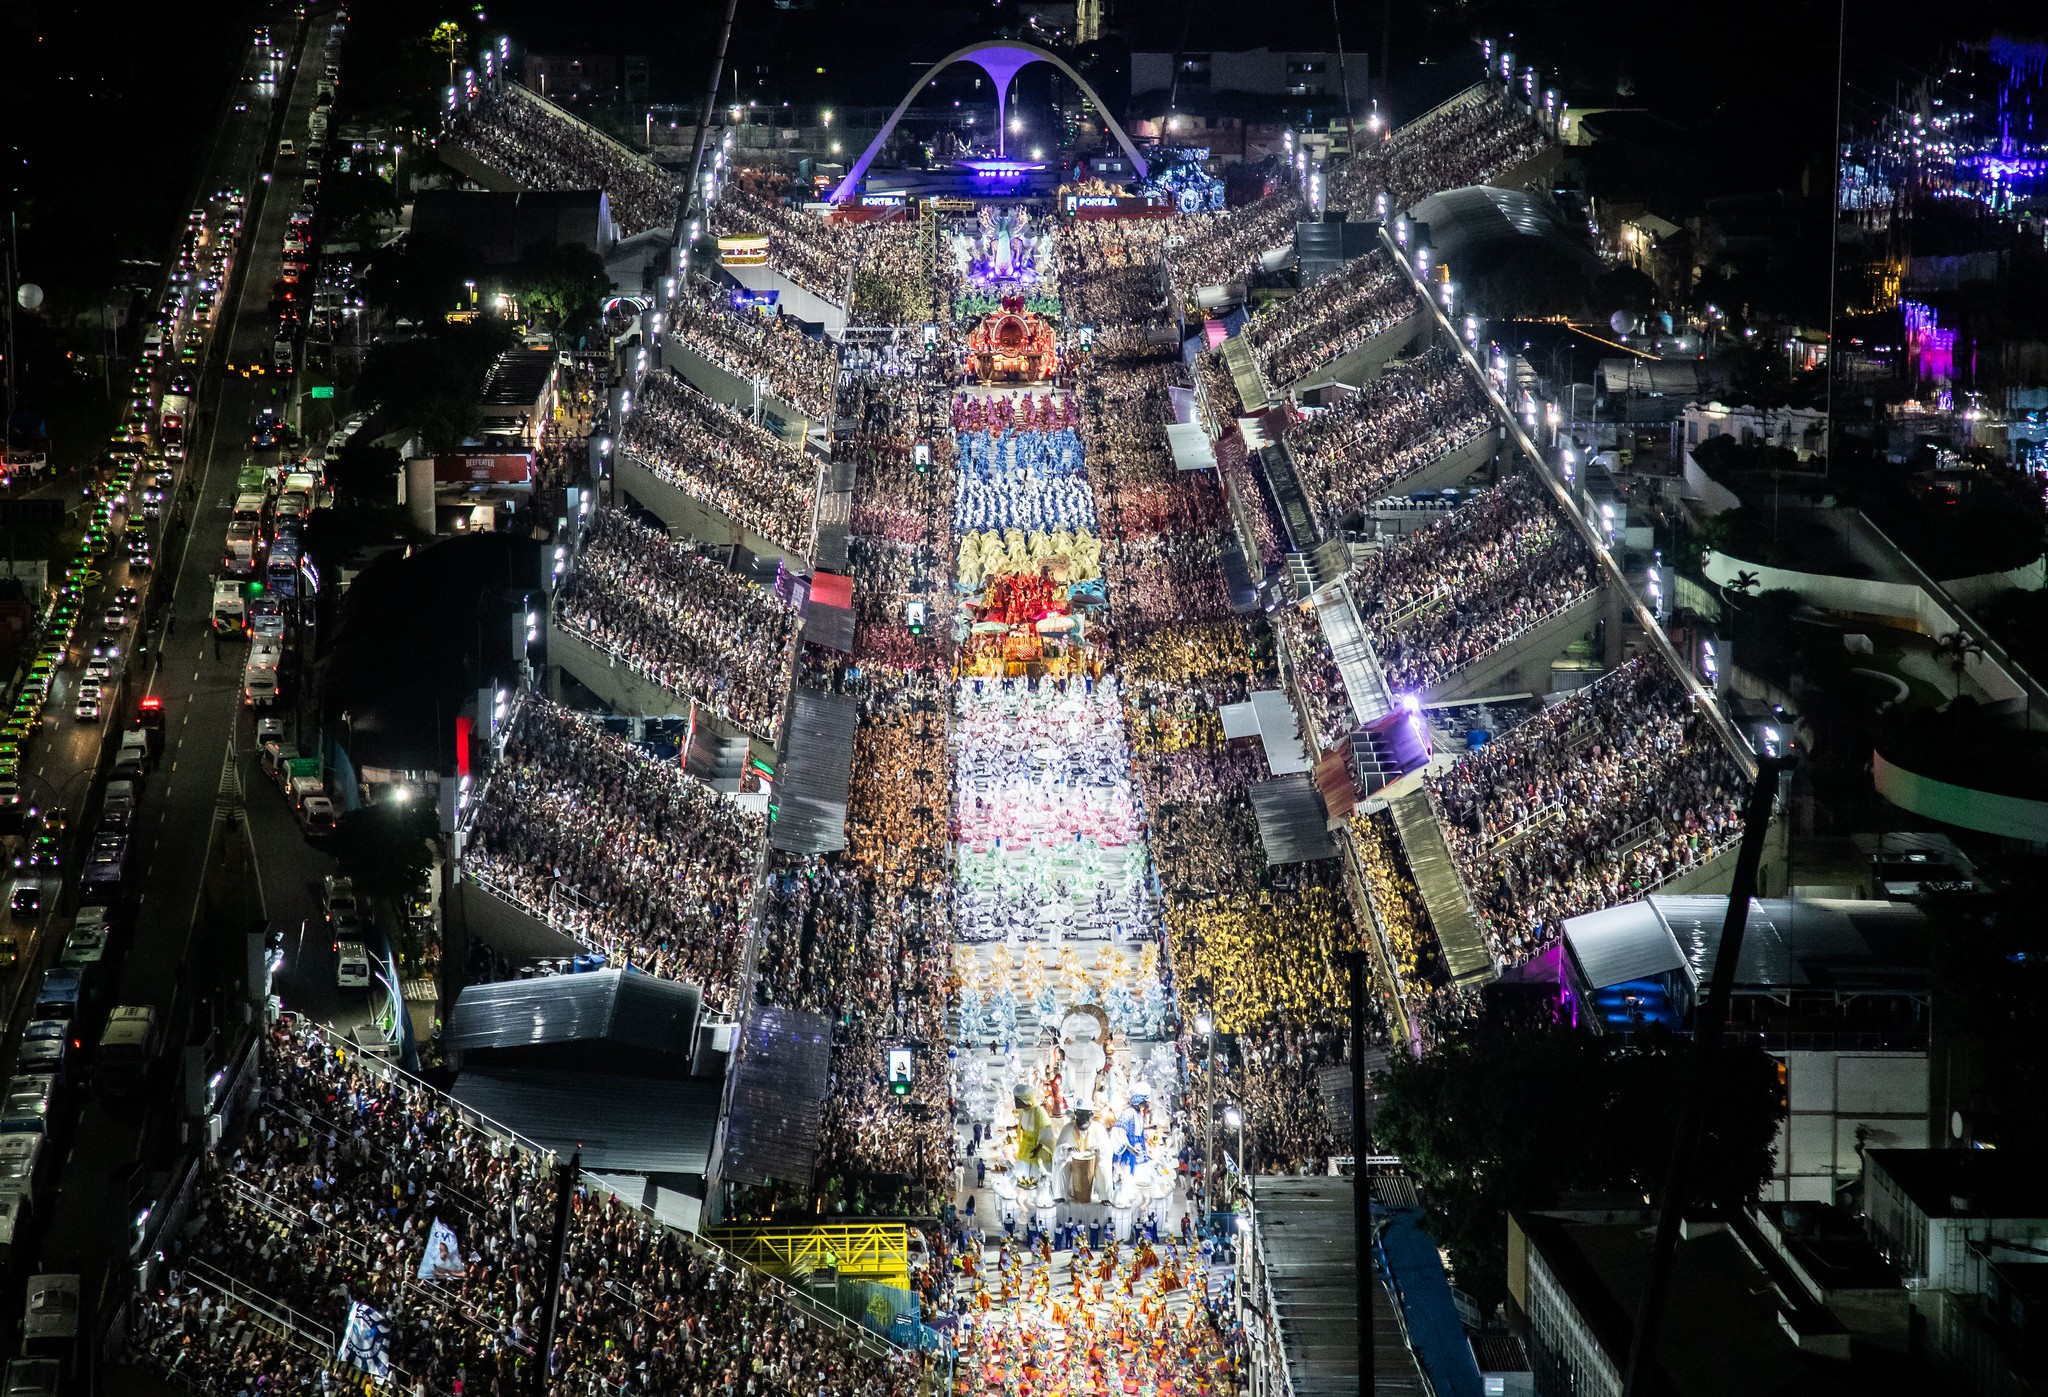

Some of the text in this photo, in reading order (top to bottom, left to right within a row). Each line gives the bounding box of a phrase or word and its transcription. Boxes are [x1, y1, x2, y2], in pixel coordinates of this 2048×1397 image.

[862, 197, 901, 206] PORTELA
[1078, 197, 1118, 206] PORTELA
[465, 458, 495, 468] BEEFEATER
